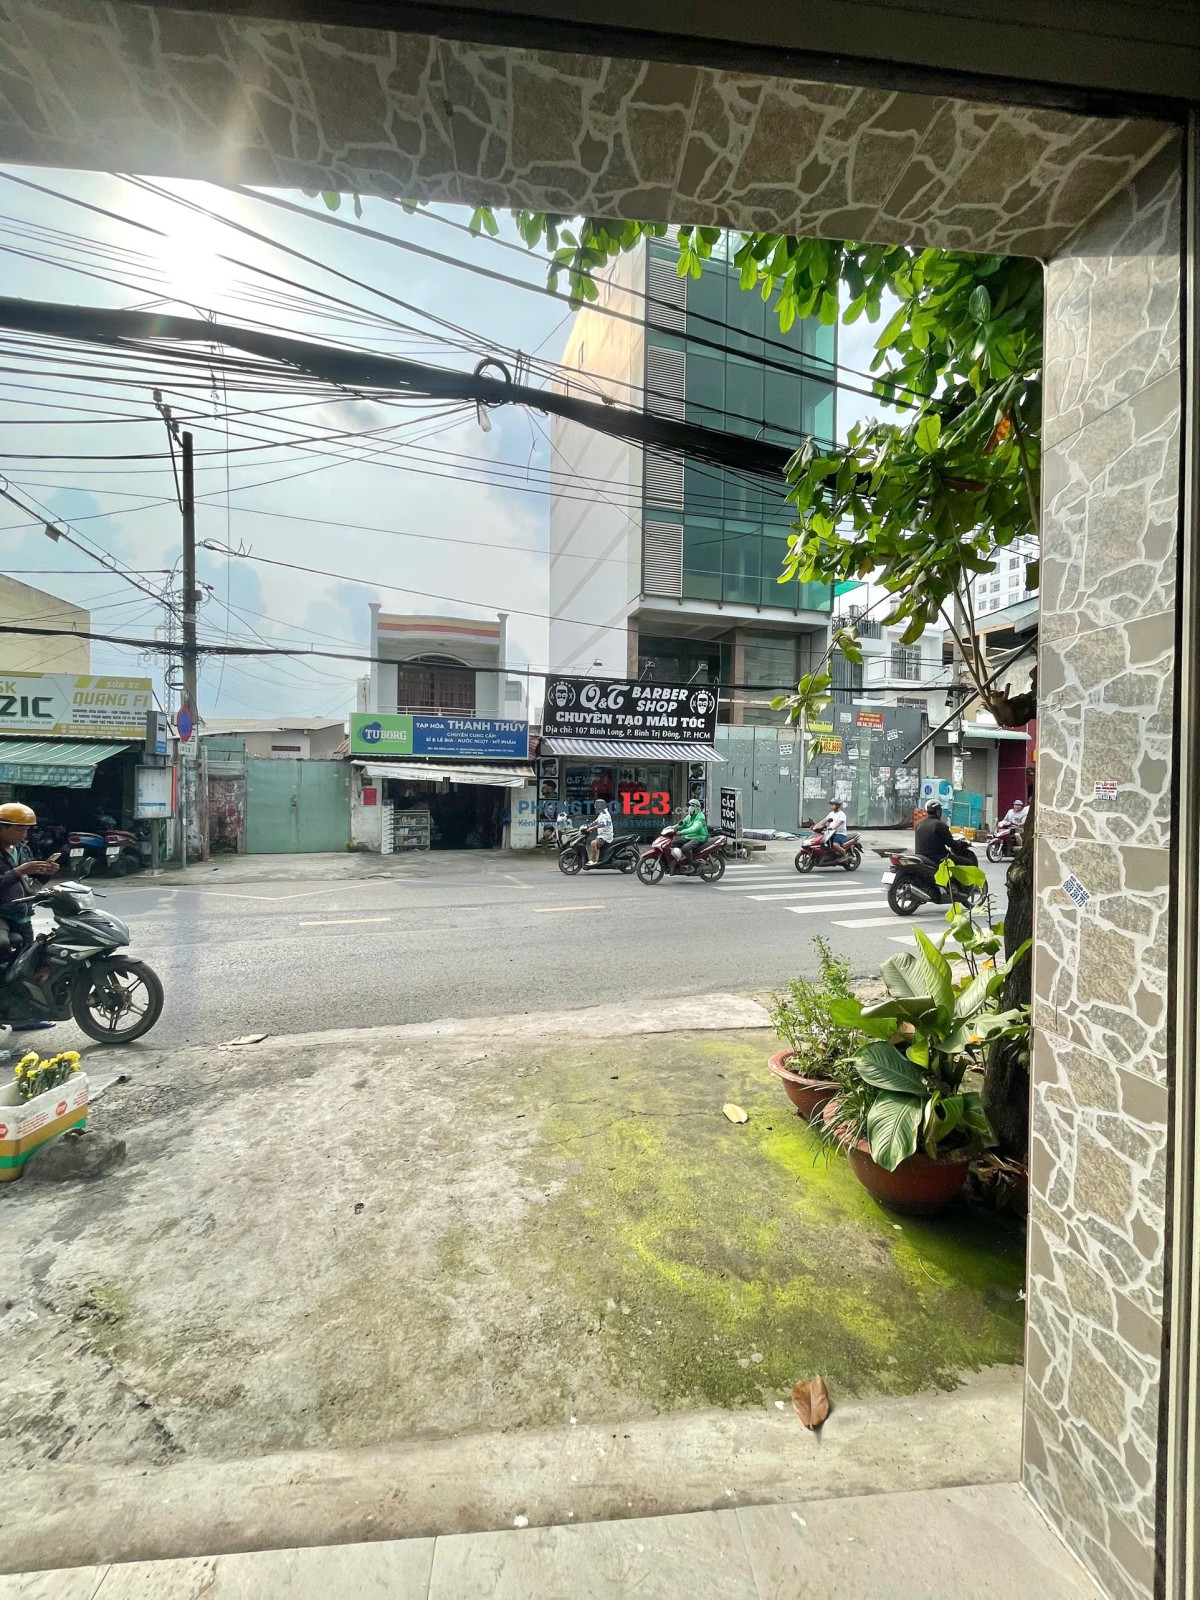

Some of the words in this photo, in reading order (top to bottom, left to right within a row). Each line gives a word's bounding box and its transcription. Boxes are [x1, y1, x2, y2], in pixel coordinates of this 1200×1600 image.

[73, 691, 128, 706] QUANG
[133, 694, 149, 707] FI
[632, 686, 688, 701] BARBER
[0, 695, 54, 718] ZIC
[636, 700, 678, 712] SHOP
[415, 722, 428, 730] TẠP
[447, 720, 490, 731] THANH
[494, 720, 526, 732] THÚY
[556, 711, 613, 724] CHUYÊN
[616, 714, 643, 727] TẠO
[681, 716, 705, 728] TÓC
[365, 729, 406, 740] TUBORG
[545, 725, 558, 734] Địa
[590, 727, 605, 735] Bình
[634, 729, 649, 737] Bình
[651, 730, 660, 738] Trị
[722, 795, 734, 808] CẮT
[722, 808, 734, 819] TÓC
[721, 819, 736, 830] NAM
